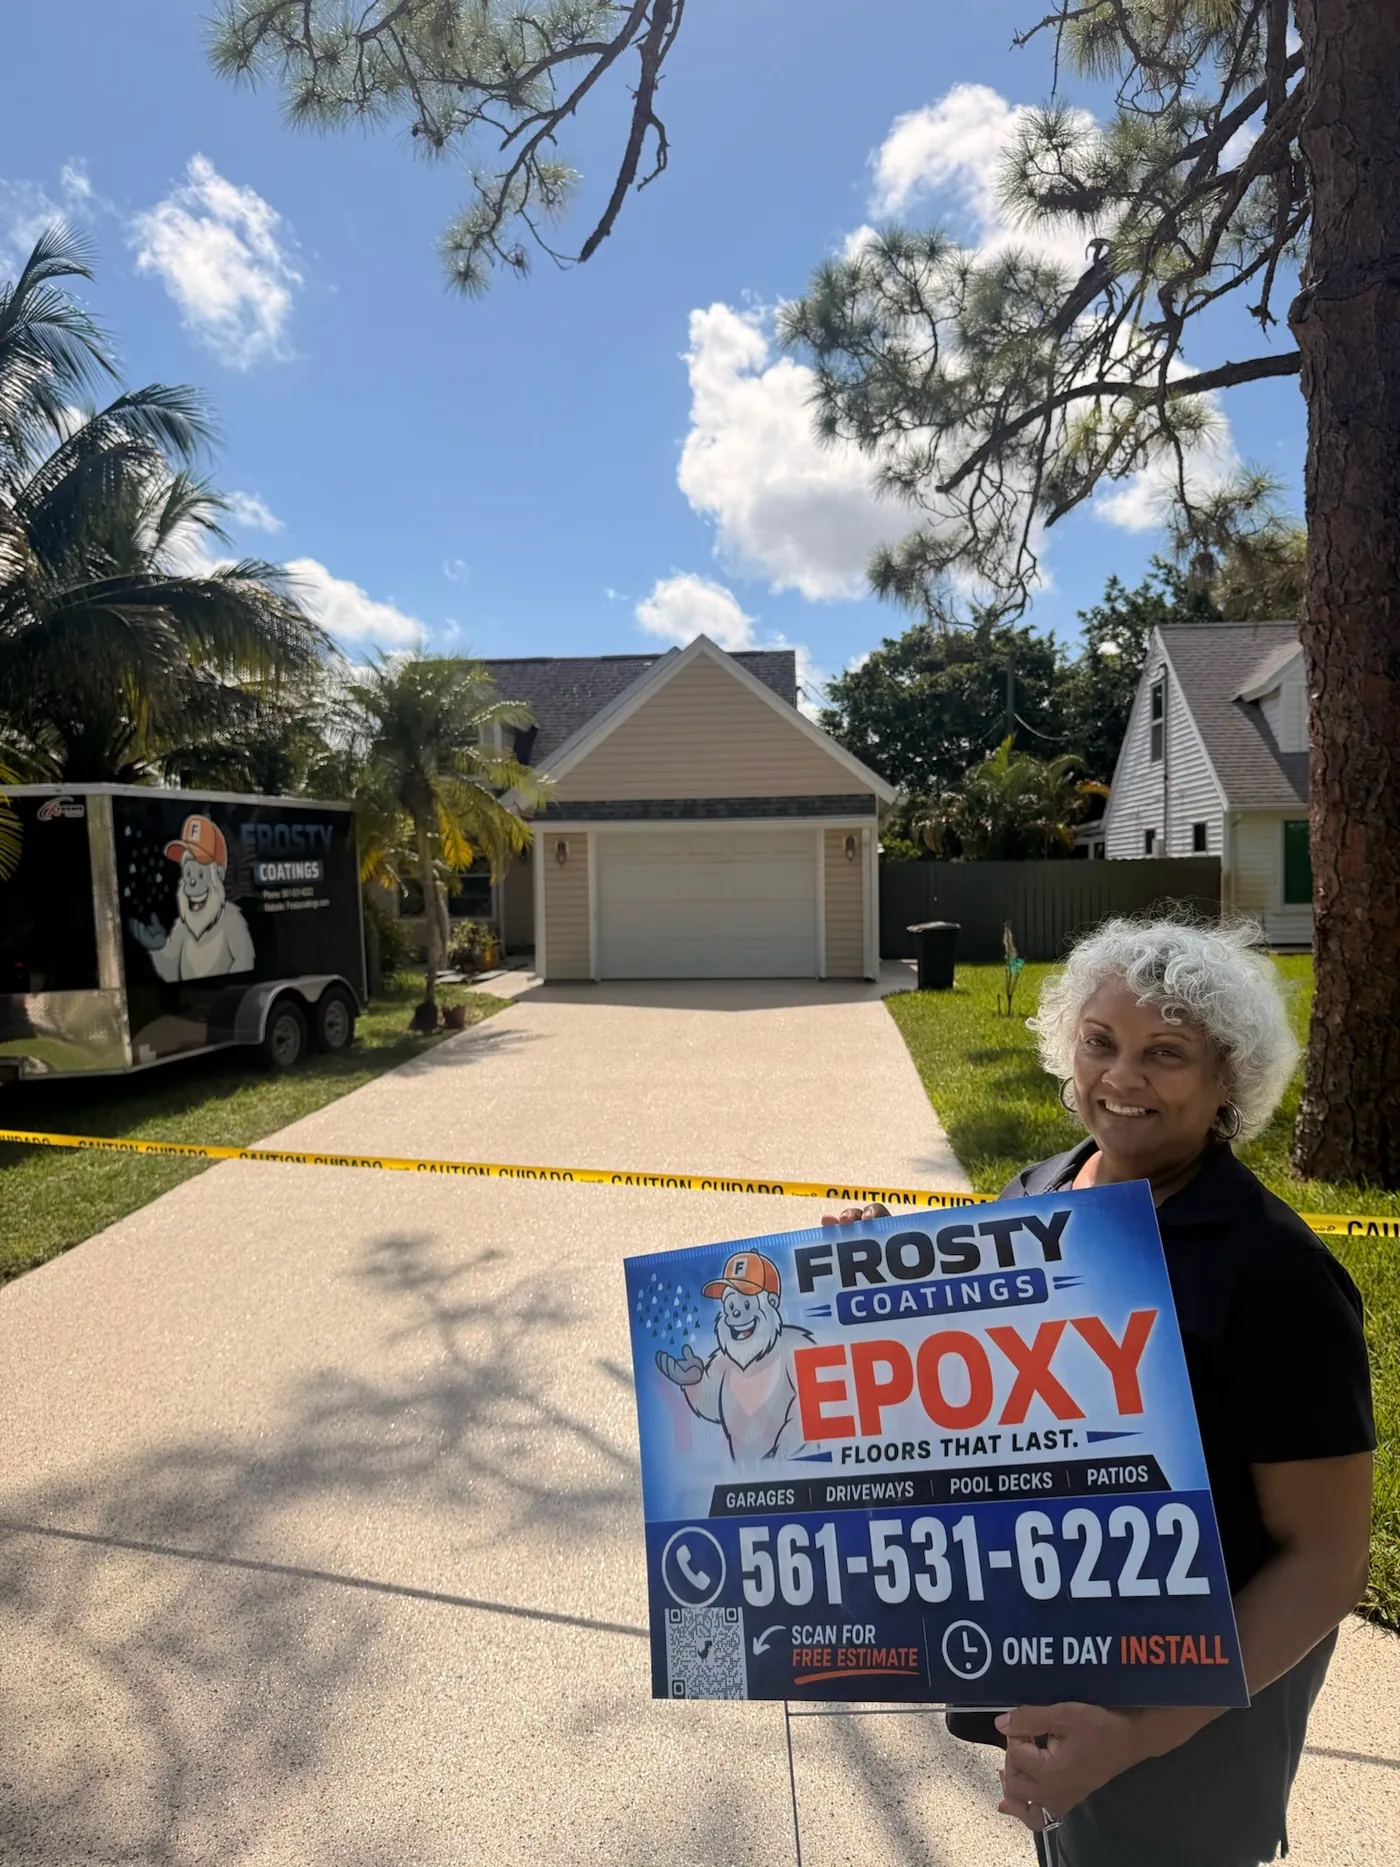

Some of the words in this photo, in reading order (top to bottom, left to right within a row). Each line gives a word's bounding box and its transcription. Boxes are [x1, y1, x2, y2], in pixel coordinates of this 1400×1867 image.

[241, 823, 334, 853] FROSTY
[260, 861, 320, 881] COATINGS
[734, 1261, 745, 1275] F
[794, 1210, 1072, 1293] FROSTY
[850, 1275, 1034, 1317] COATINGS
[794, 1309, 1158, 1441] EPOXY
[841, 1440, 932, 1465] FLOORS
[940, 1435, 1002, 1457] THAT
[1012, 1429, 1079, 1452] LAST.
[726, 1488, 795, 1508] GARAGES
[826, 1481, 914, 1502] DRIVEWAYS
[950, 1476, 993, 1495] POOL
[999, 1471, 1053, 1492] DECKS
[1087, 1465, 1149, 1486] PATIOS
[739, 1502, 1211, 1607] 561-531-6222
[791, 1625, 837, 1645] SCAN
[842, 1624, 876, 1645] FOR
[1002, 1636, 1054, 1665] ONE
[1062, 1636, 1113, 1665] DAY
[1120, 1635, 1230, 1665] INSTALL
[792, 1648, 831, 1667] FREE
[836, 1648, 919, 1667] ESTIMATE
